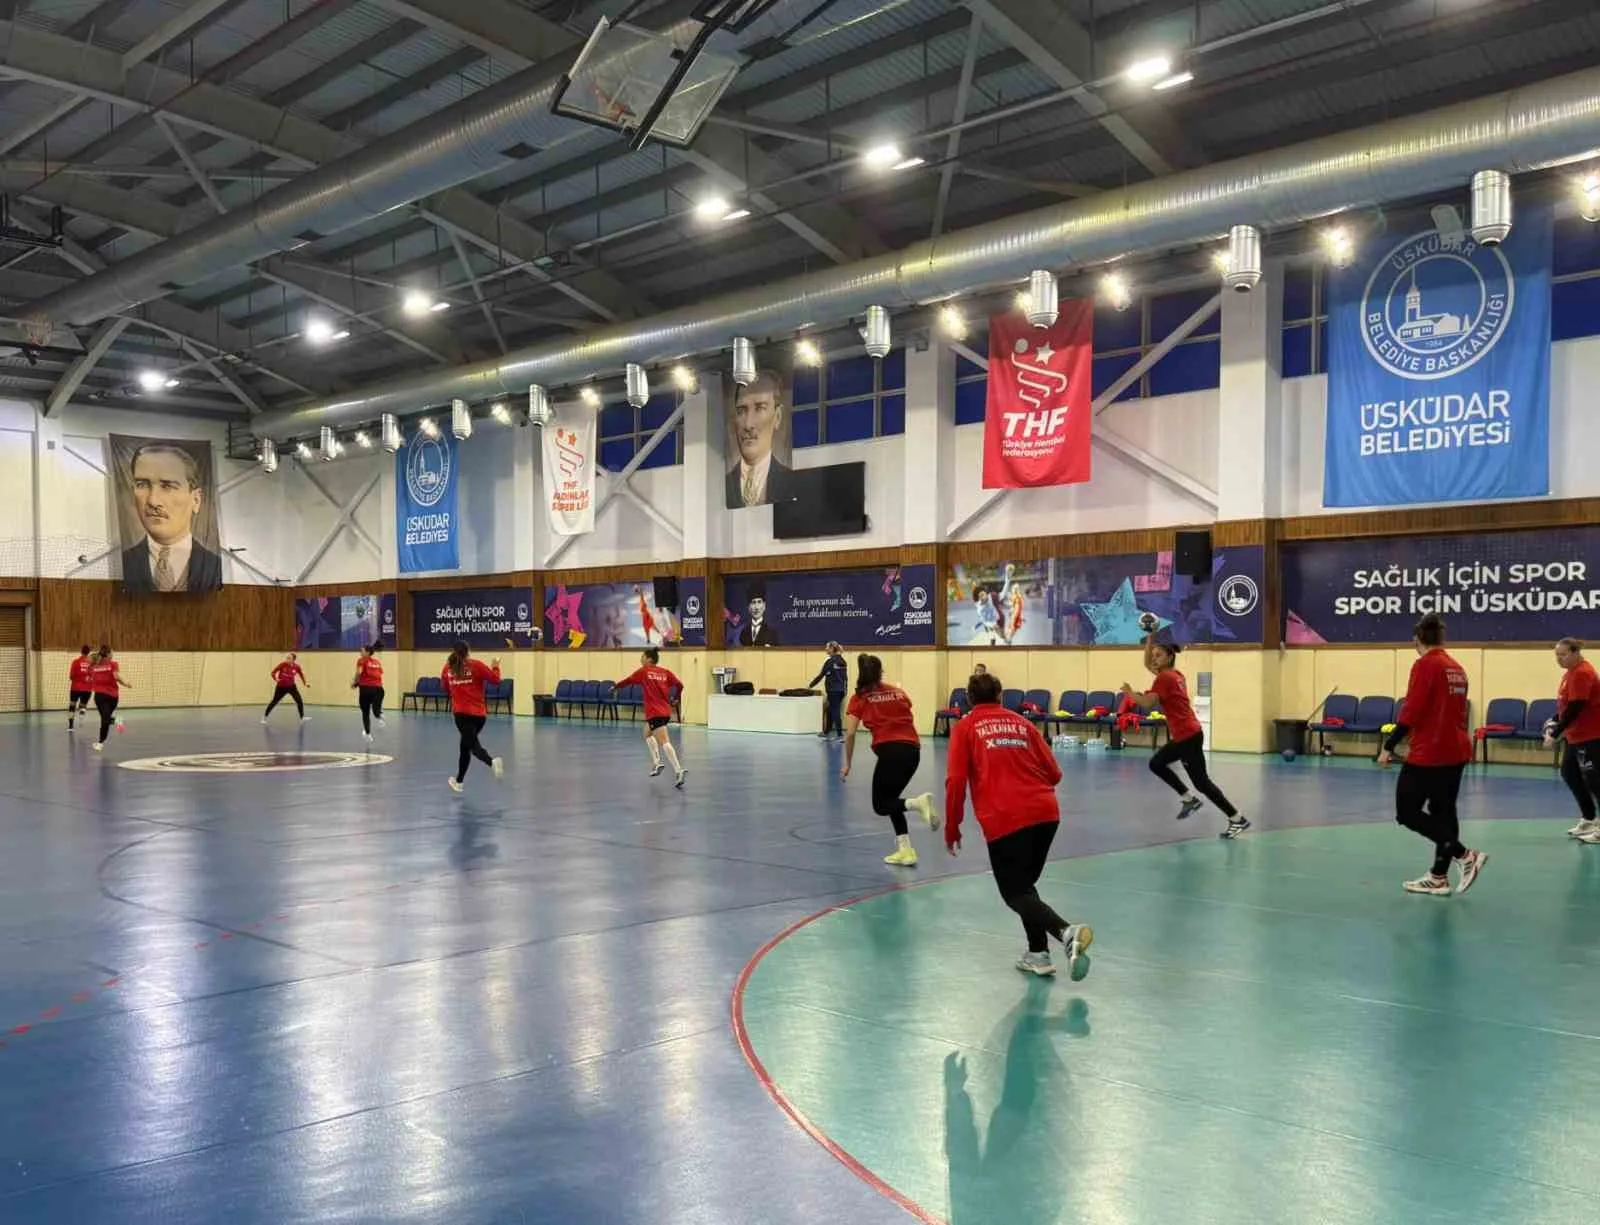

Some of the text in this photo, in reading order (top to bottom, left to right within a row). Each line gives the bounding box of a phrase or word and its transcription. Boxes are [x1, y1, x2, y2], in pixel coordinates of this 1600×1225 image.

[1003, 406, 1069, 438] THF
[1360, 389, 1511, 431] ÜSKÜDAR
[1354, 561, 1586, 591] SAĞLIK İÇİN SPOR
[436, 605, 505, 620] SAĞLIK İÇİN SPOR
[1335, 597, 1401, 615] SPOR
[1410, 589, 1461, 614] İÇİN
[431, 623, 451, 633] SPOR
[453, 620, 469, 635] İÇİN
[471, 619, 511, 632] ÜSKÜDAR
